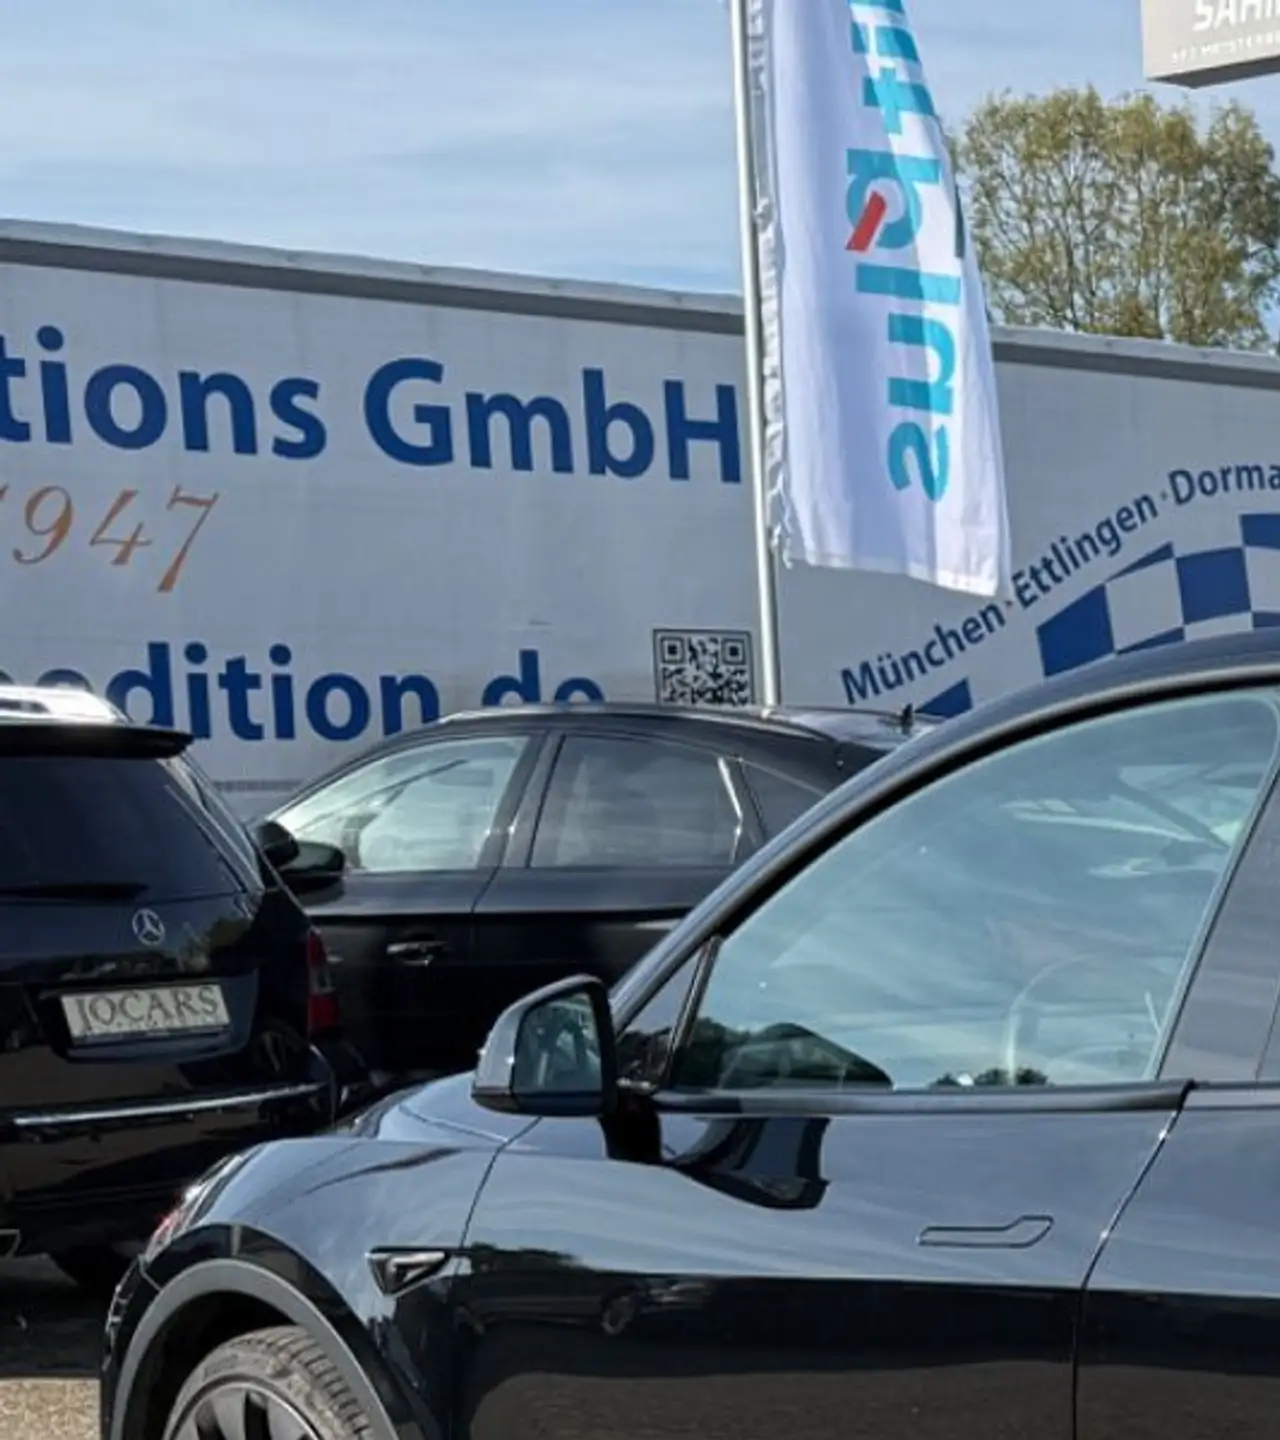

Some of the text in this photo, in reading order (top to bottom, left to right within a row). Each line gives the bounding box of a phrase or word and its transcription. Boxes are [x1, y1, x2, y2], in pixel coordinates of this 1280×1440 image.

[363, 357, 743, 484] GmbH
[0, 481, 220, 595] 947
[841, 600, 1006, 706] München
[1011, 493, 1158, 609] Ettlingen
[76, 985, 218, 1032] JOCARS
